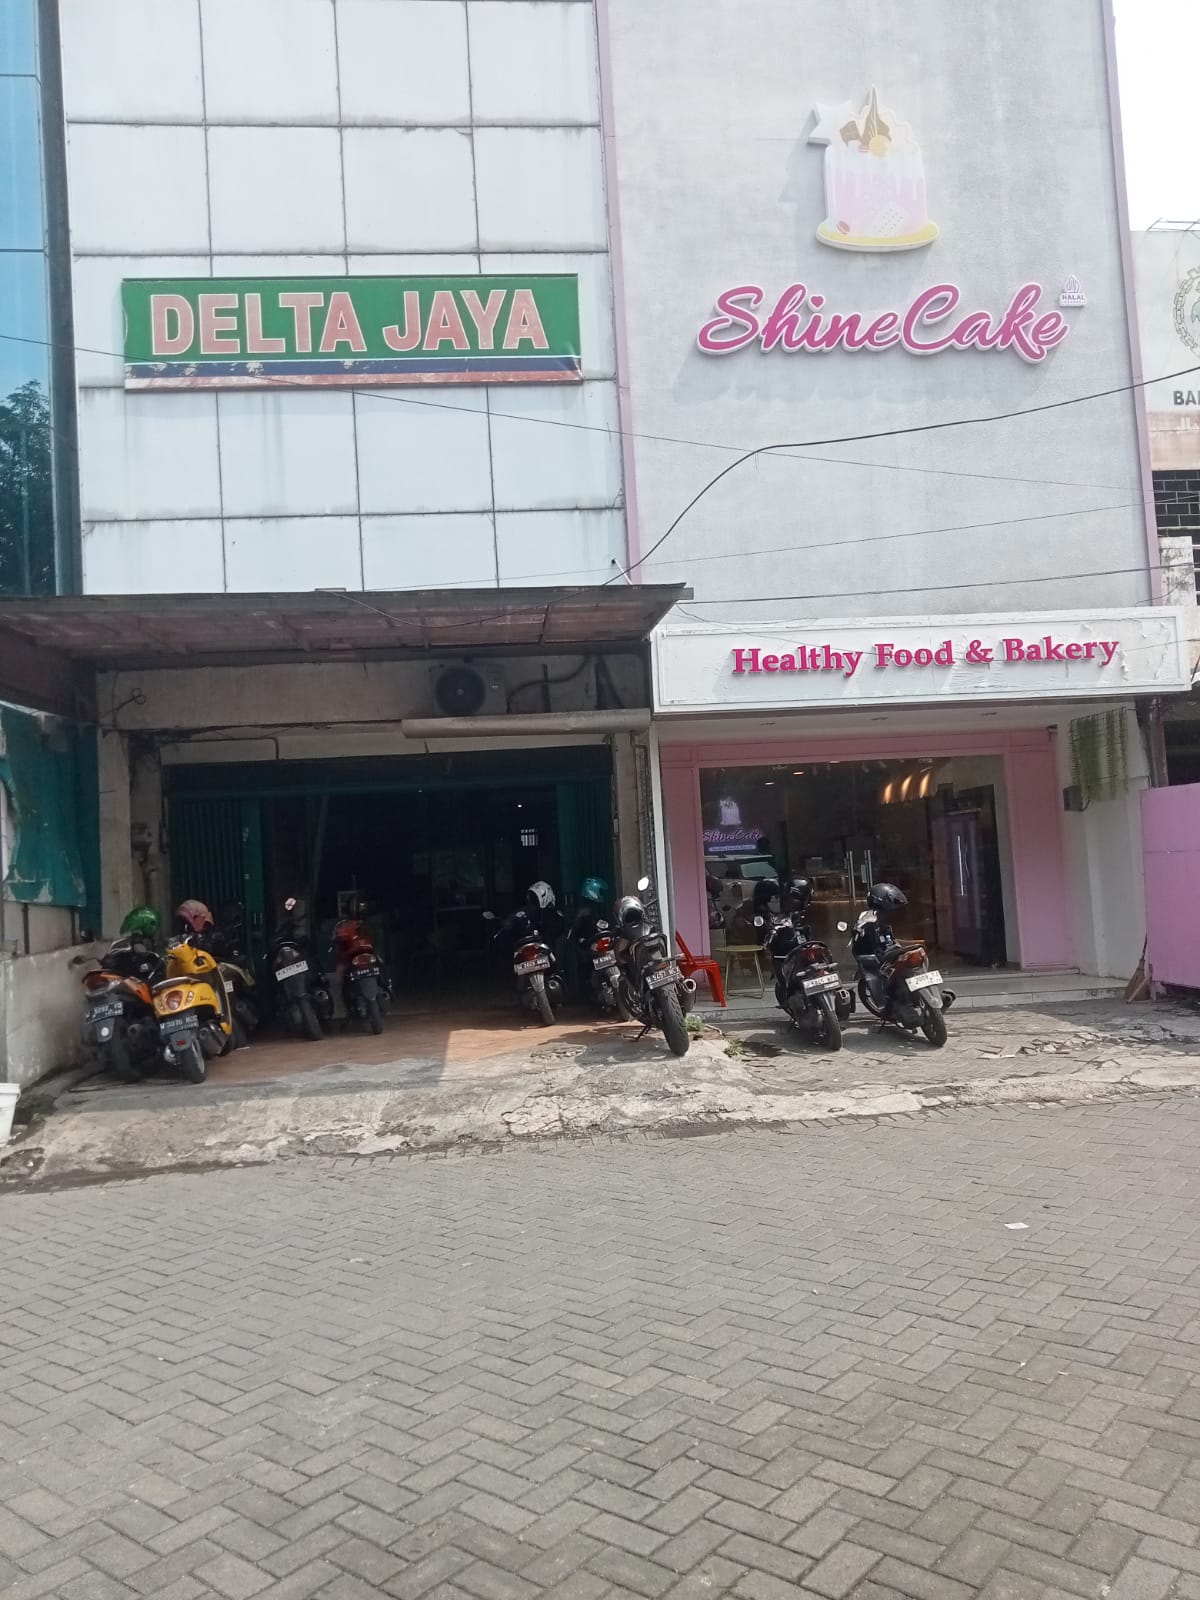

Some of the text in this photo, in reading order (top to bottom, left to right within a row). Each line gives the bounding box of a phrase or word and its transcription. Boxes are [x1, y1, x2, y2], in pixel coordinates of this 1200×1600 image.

[149, 288, 550, 356] DELTA JAYA
[1173, 390, 1200, 406] BA
[732, 635, 1119, 678] Healthy Food & Bakery
